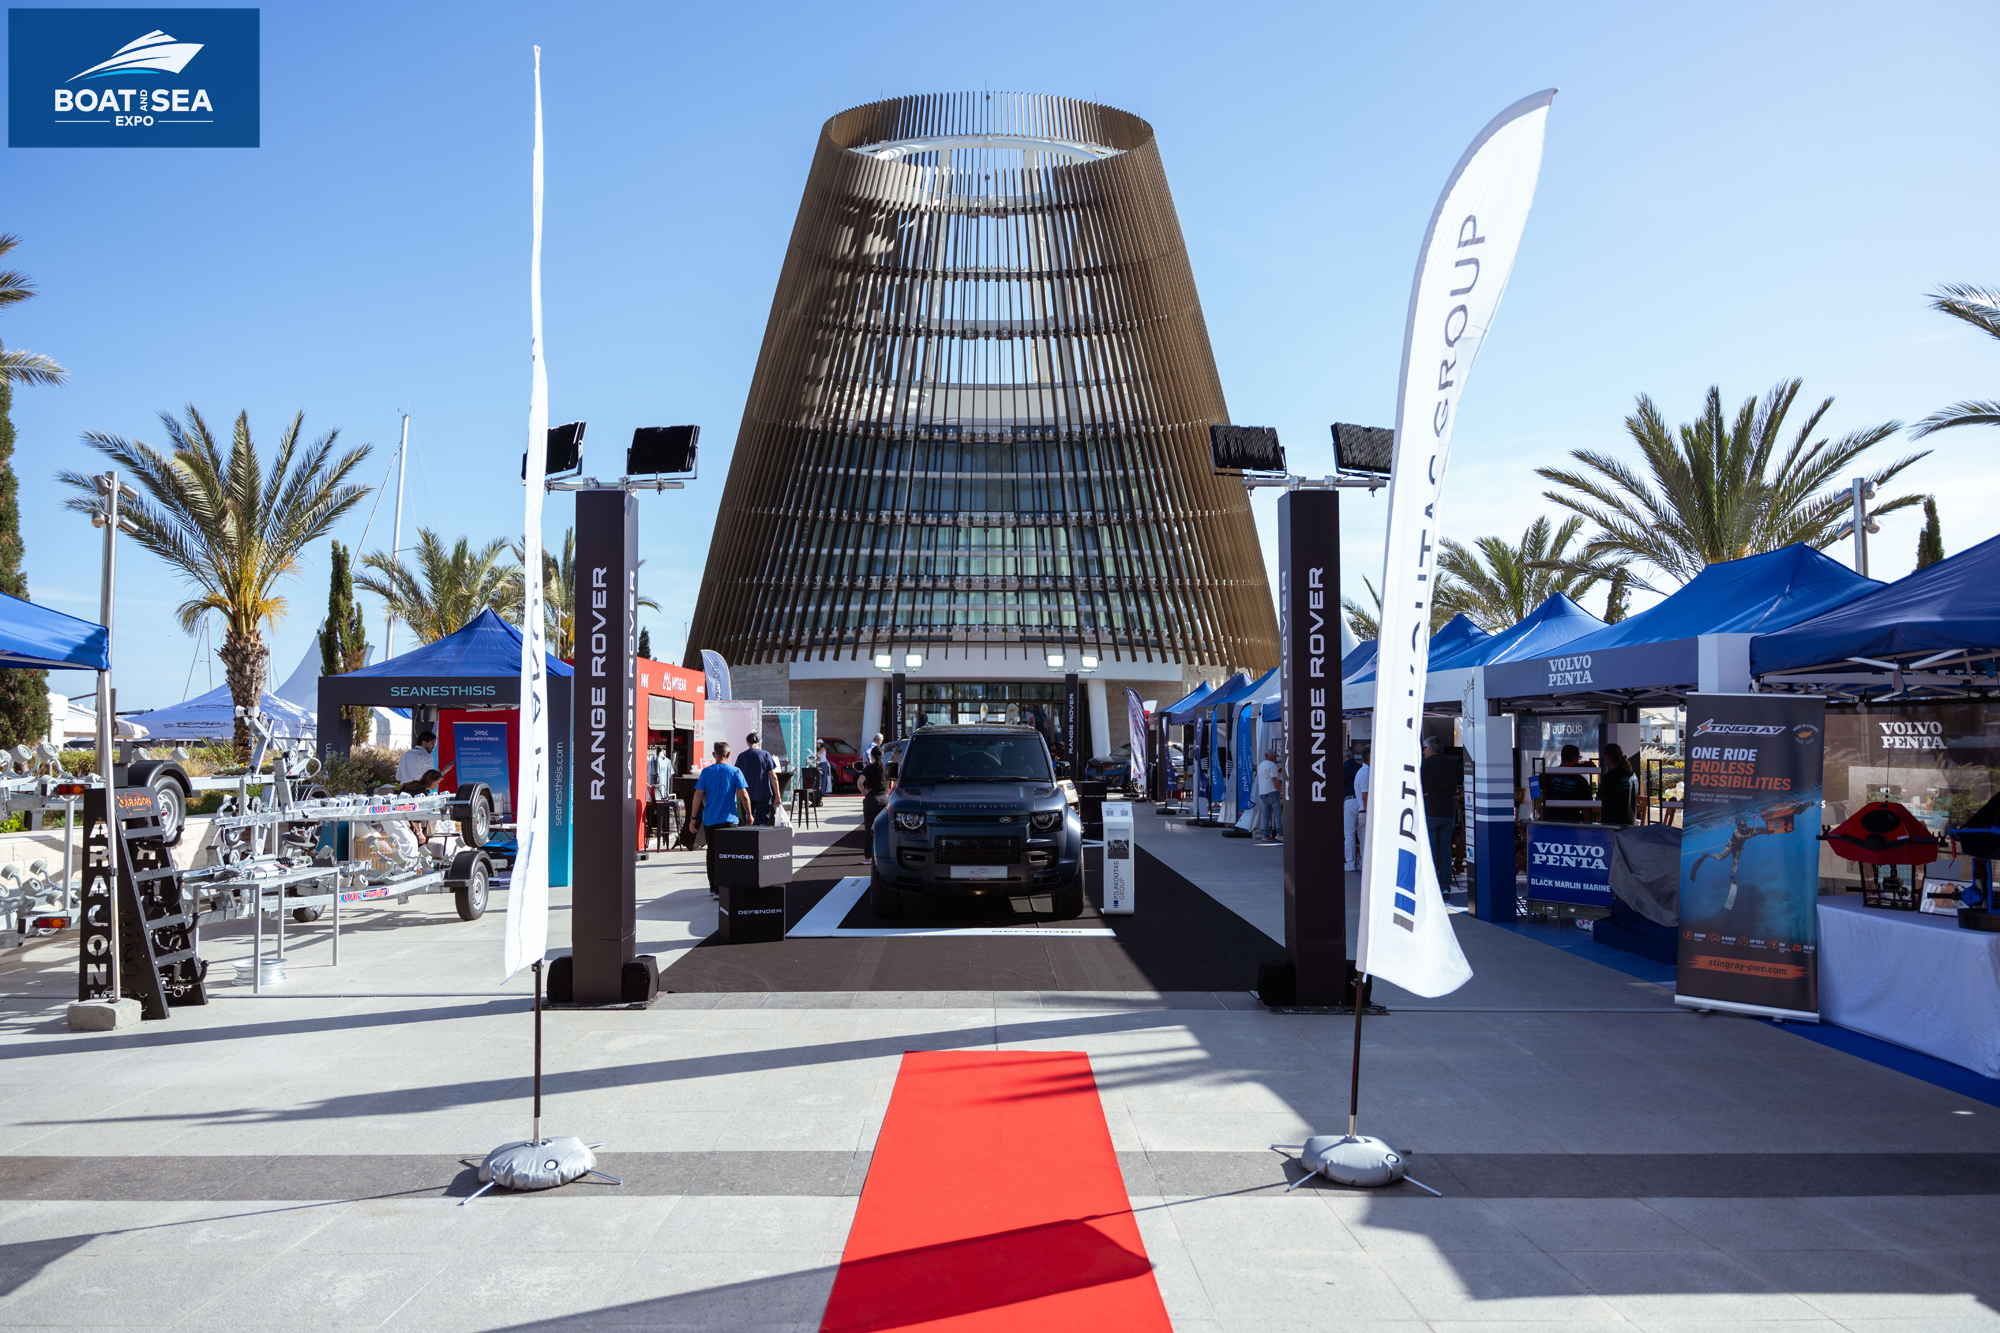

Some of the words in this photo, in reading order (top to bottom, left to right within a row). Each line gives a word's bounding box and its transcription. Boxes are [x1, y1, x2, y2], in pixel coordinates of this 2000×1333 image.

[1433, 214, 1486, 438] GROUP
[591, 566, 607, 677] ROVER
[628, 570, 636, 678] ROVER
[1308, 567, 1325, 678] ROVER
[1548, 655, 1592, 672] VOLVO
[1548, 670, 1593, 687] PENTA
[390, 685, 496, 697] SEANESTHISIS
[1552, 724, 1583, 735] DUFOUR
[1693, 718, 1787, 737] STINGRAY
[1879, 721, 1943, 735] VOLVO
[590, 686, 606, 800] RANGE
[626, 687, 634, 799] RANGE
[1310, 688, 1327, 802] RANGE
[1881, 736, 1947, 749] PENTA
[1691, 746, 1721, 760] ONE
[1723, 747, 1758, 762] RIDE
[1691, 760, 1755, 775] ENDLESS
[554, 741, 564, 827] seanesthisis.com
[1690, 773, 1792, 791] POSSIBILITIES
[762, 852, 791, 860] DEFENDER
[1533, 842, 1605, 858] VOLVO
[1532, 853, 1609, 870] PENTA
[1530, 878, 1553, 887] BLACK
[1554, 880, 1581, 890] MARLIN
[1582, 883, 1611, 892] MARINE
[1708, 958, 1787, 975] stingray-pwc.com
